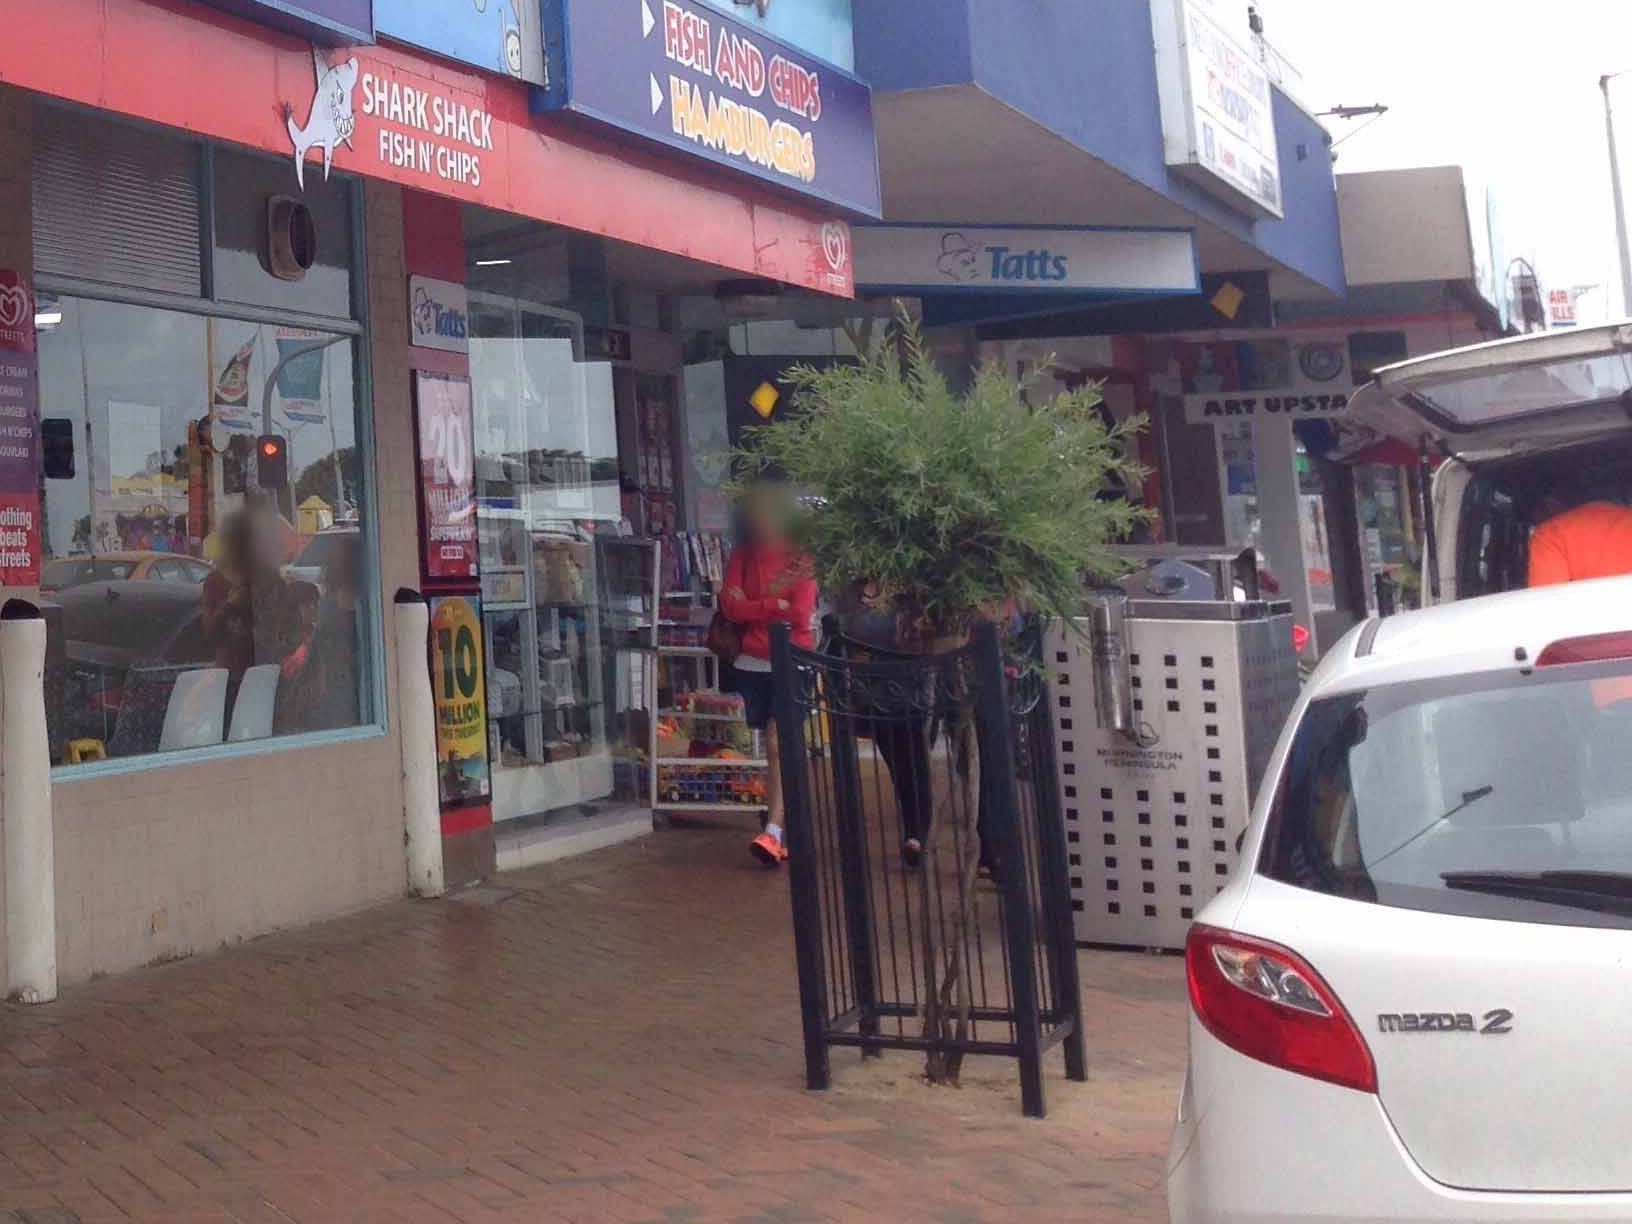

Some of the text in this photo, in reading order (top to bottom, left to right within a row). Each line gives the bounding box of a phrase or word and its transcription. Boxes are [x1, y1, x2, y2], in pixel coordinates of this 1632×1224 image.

[663, 0, 822, 121] FISH AND CHIPS
[362, 73, 493, 151] SHARK SHACK
[669, 75, 817, 183] HAMBURGERS
[379, 129, 415, 169] FISH
[436, 146, 481, 187] CHIPS
[984, 246, 1068, 281] Tatts
[433, 302, 466, 338] Tatts
[1204, 398, 1257, 417] ART
[0, 527, 28, 548] beats
[437, 624, 478, 699] 10
[439, 702, 481, 726] MILLION
[1479, 1008, 1514, 1035] 2
